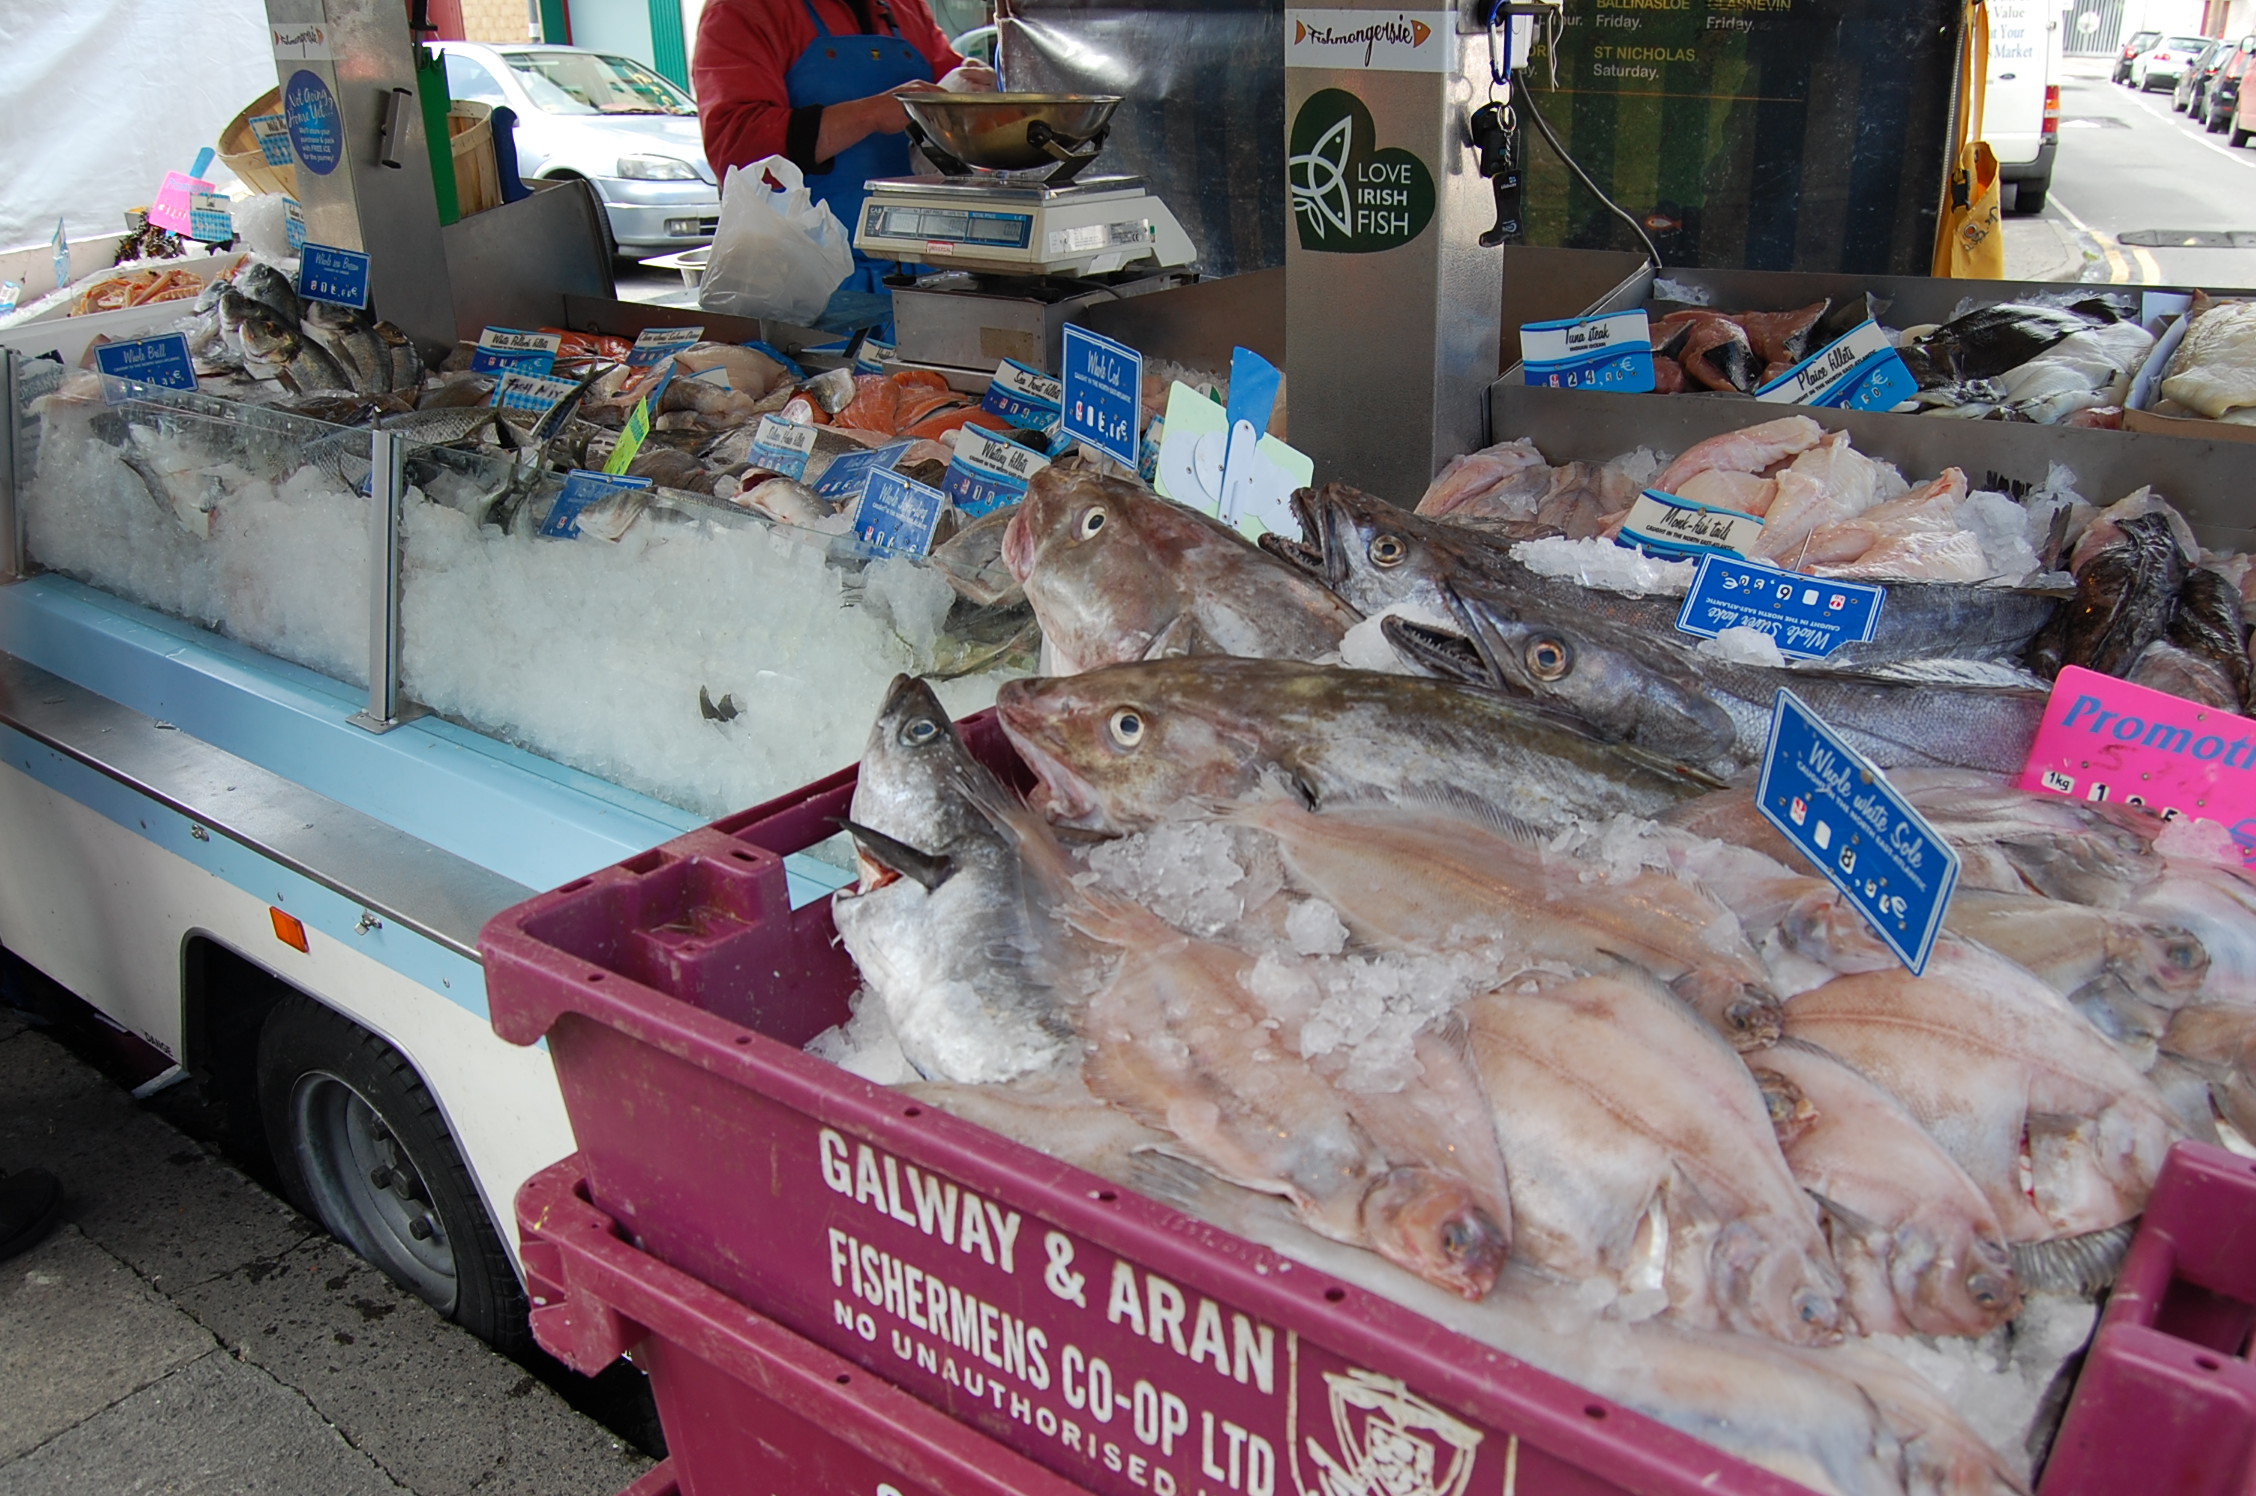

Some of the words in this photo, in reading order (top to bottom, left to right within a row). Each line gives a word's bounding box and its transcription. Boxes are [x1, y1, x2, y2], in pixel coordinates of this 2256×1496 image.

[1597, 0, 1690, 9] BALLINASLOE
[1994, 6, 2025, 18] Value
[1596, 14, 1642, 31] Friday.
[1706, 16, 1755, 33] Friday.
[2000, 24, 2025, 39] Your
[1594, 46, 1612, 59] ST
[1616, 46, 1696, 62] NICHOLAS
[1994, 43, 2033, 58] Market
[1593, 63, 1660, 80] Saturday.
[1358, 162, 1412, 184] LOVE
[1357, 188, 1408, 206] IRISH
[1357, 210, 1409, 236] FISH
[1563, 327, 1586, 345] Tuna
[1587, 323, 1610, 342] steak
[1796, 365, 1829, 391] Plaice
[1828, 345, 1856, 372] fillets
[1815, 382, 1825, 393] THE
[1825, 372, 1843, 387] NORTH
[1645, 524, 1666, 535] CAUGHT
[1672, 531, 1683, 540] THE
[1683, 533, 1699, 544] NORTH
[1709, 519, 1735, 542] tails
[1762, 611, 1783, 621] NORTH
[1784, 615, 1800, 624] THE
[1787, 625, 1831, 650] Whole
[1821, 624, 1841, 632] CAUGHT
[2049, 771, 2070, 791] 1kg
[1808, 740, 1852, 798] Whole
[1852, 793, 1888, 832] white
[1890, 821, 1923, 868] Sole
[1836, 796, 1850, 813] THE
[1850, 810, 1877, 838] NORTH
[818, 1128, 1021, 1275] GALWAY
[1043, 1230, 1087, 1309] &
[1107, 1259, 1276, 1395] ARAN
[828, 1226, 1051, 1392] FISHERMENS
[1061, 1343, 1189, 1457] CO-OP
[1201, 1410, 1276, 1496] LTD
[833, 1299, 877, 1341] NO
[891, 1329, 1178, 1496] UNAUTHORISED
